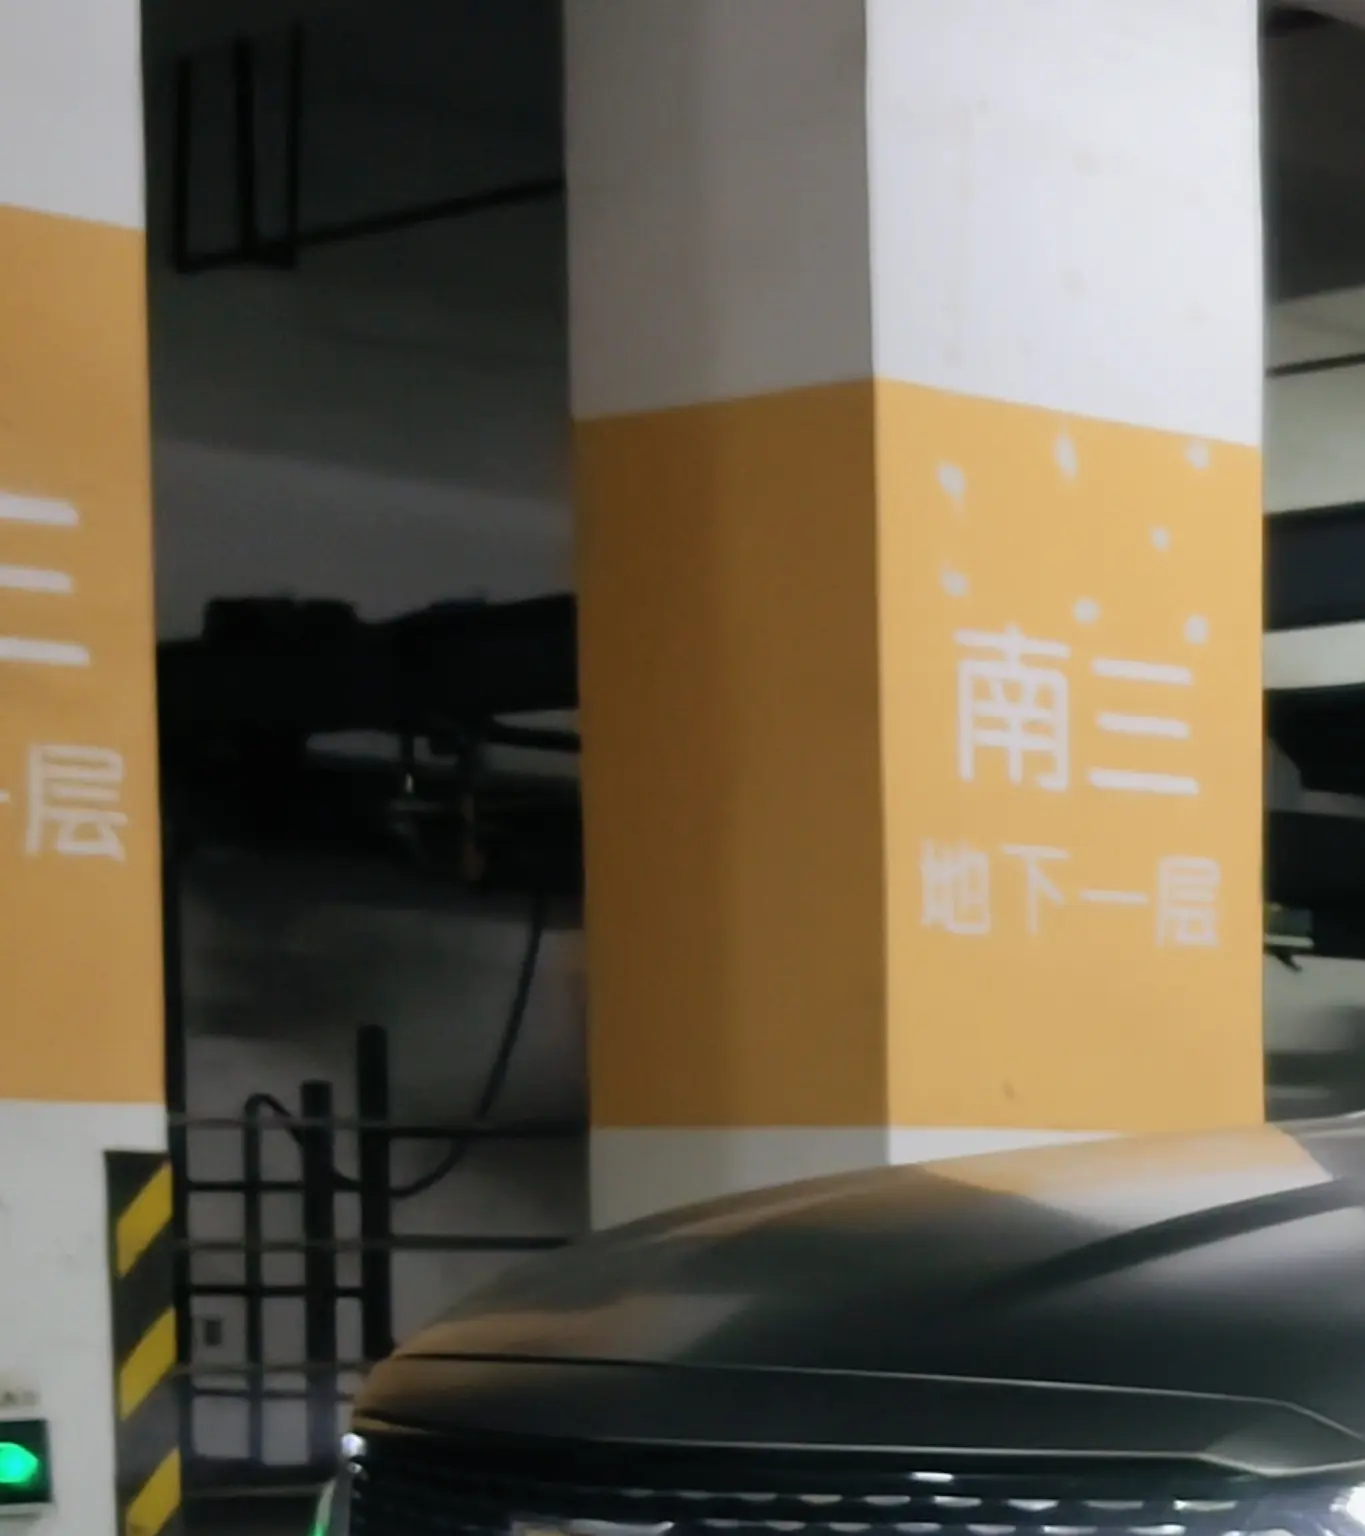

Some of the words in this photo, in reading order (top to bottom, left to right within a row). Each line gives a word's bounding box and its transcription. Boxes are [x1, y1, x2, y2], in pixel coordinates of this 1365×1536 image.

[953, 622, 1199, 796] 南三
[919, 838, 1220, 948] 地下一层
